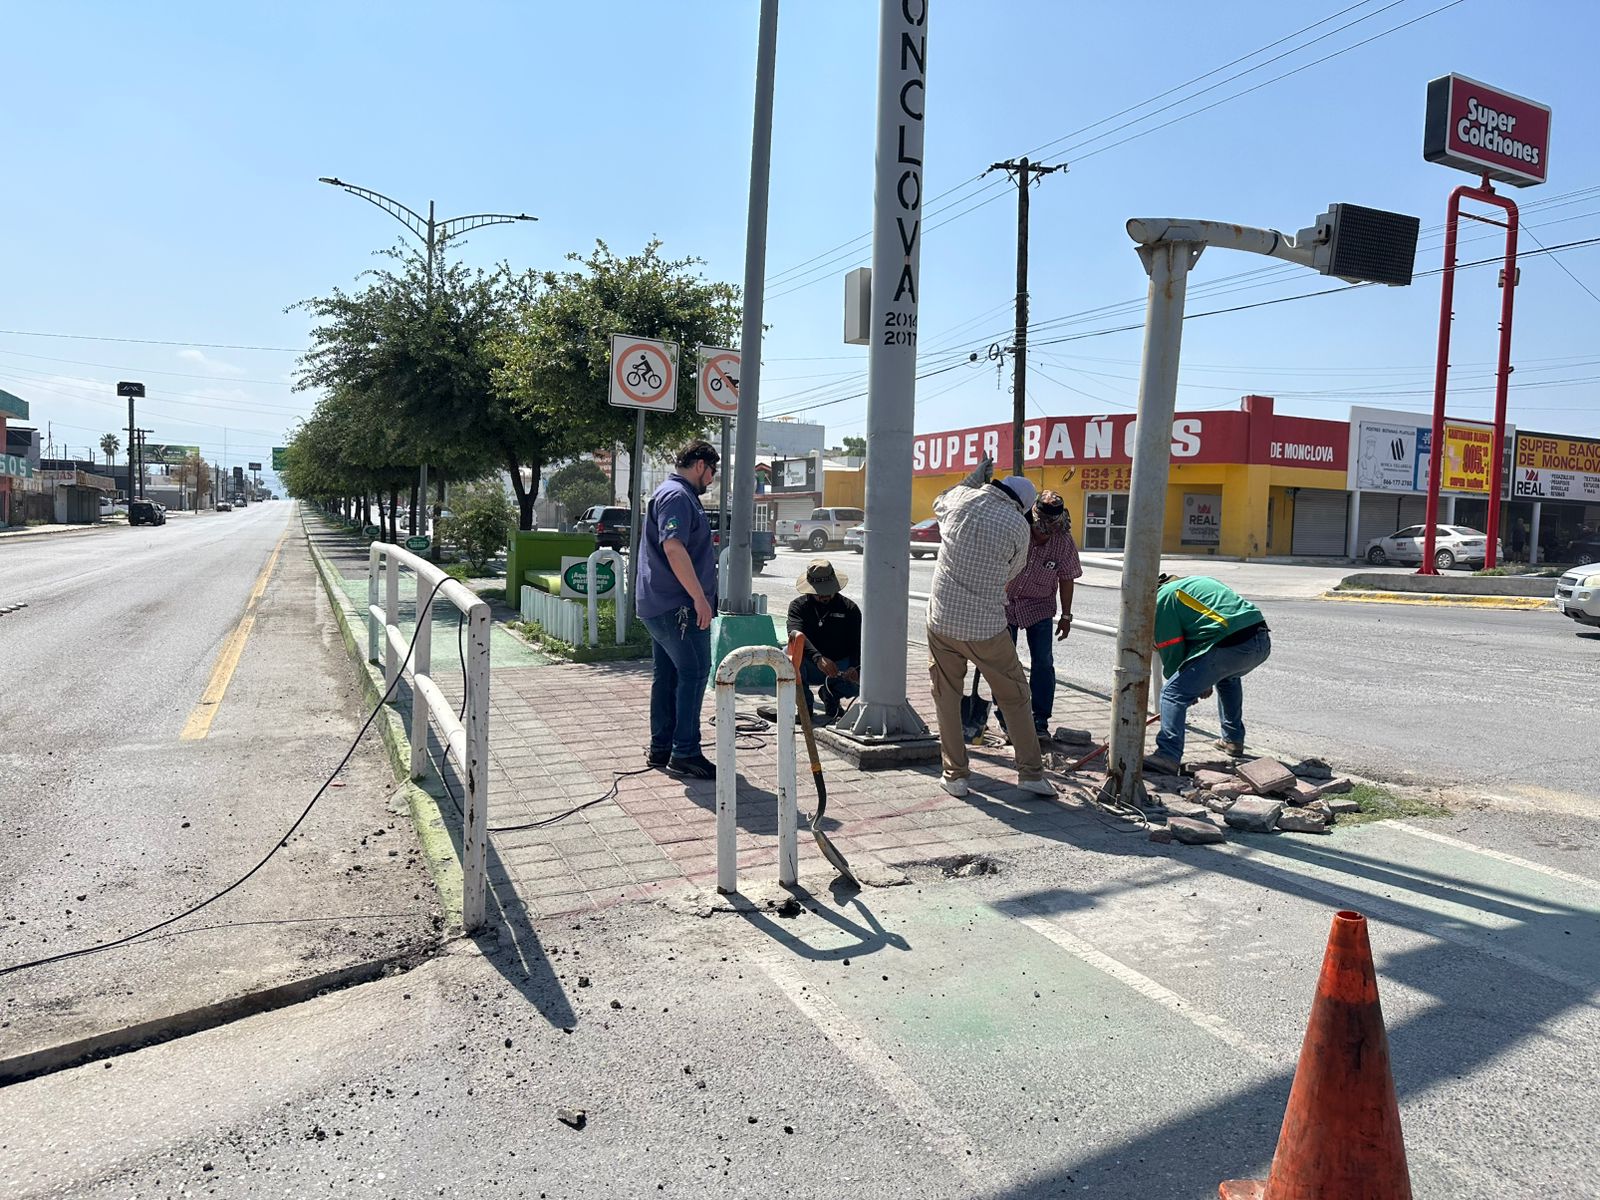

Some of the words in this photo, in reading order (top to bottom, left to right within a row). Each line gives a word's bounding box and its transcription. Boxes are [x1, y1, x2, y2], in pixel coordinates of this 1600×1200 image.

[1467, 96, 1517, 134] Super
[1457, 118, 1540, 165] Colchones
[912, 430, 999, 472] SUPER
[1270, 441, 1286, 459] DE
[1284, 443, 1334, 463] MONCLOVA
[1519, 438, 1558, 455] SUPER
[1519, 452, 1536, 466] DE
[1542, 454, 1600, 473] MONCLOV
[1516, 480, 1546, 497] REAL
[1188, 514, 1218, 526] REAL
